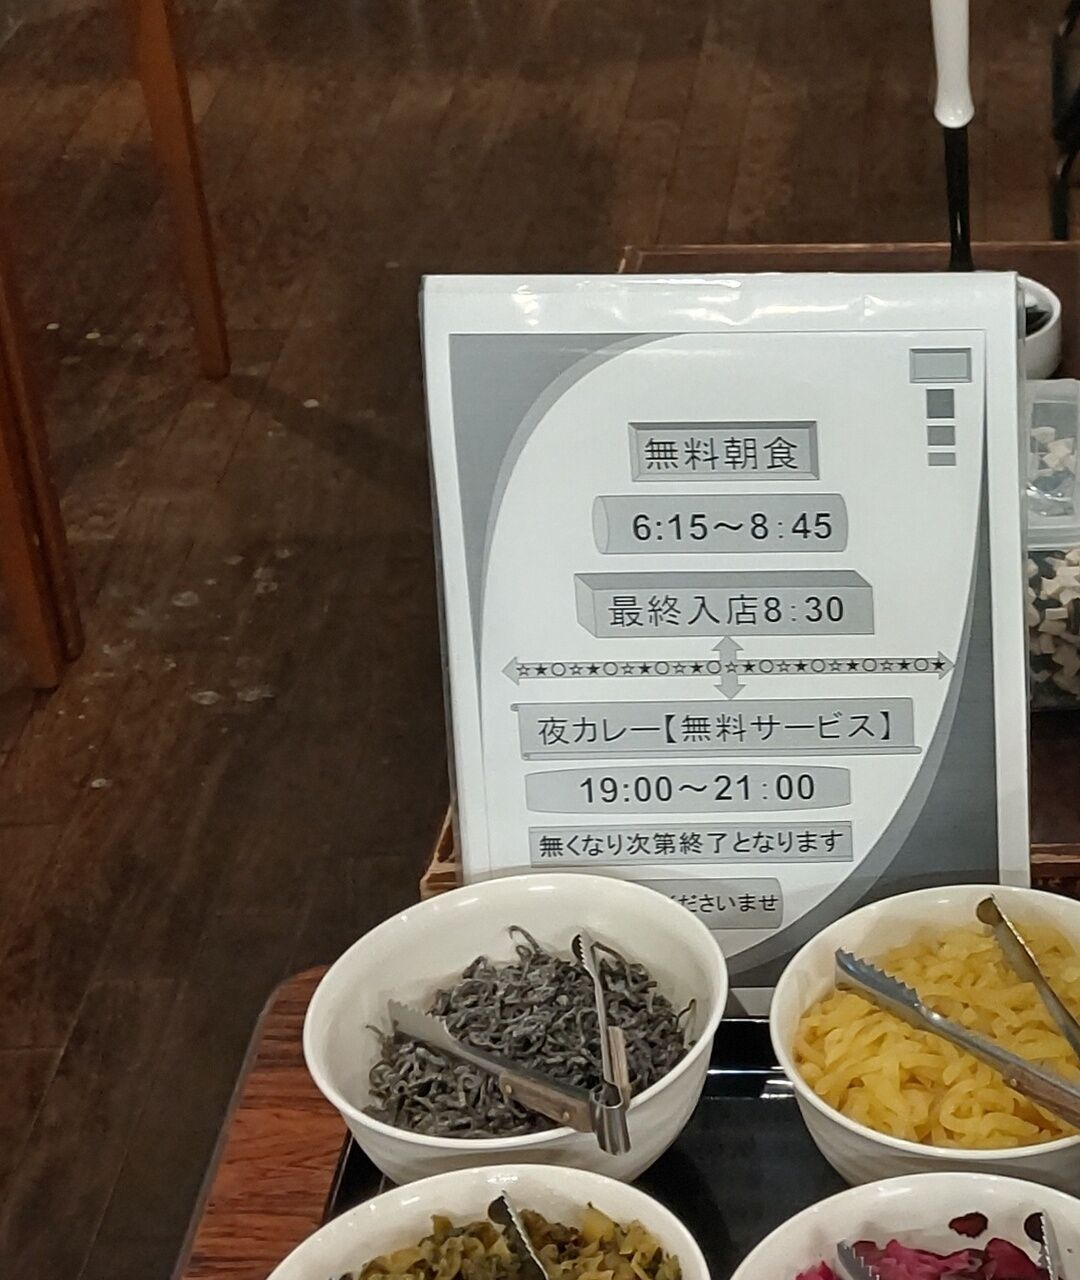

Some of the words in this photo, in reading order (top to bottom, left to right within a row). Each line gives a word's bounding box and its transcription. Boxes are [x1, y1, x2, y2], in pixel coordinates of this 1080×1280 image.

[644, 436, 798, 470] 無料朝食
[632, 513, 832, 540] 6:15～8:45
[608, 594, 844, 627] 最終入店8:30
[537, 710, 891, 746] 夜カレー【無料サービス】
[580, 773, 815, 804] 19:00～21:00
[539, 829, 844, 858] 無くなり次第終了となります
[671, 892, 779, 913] ださいませ
